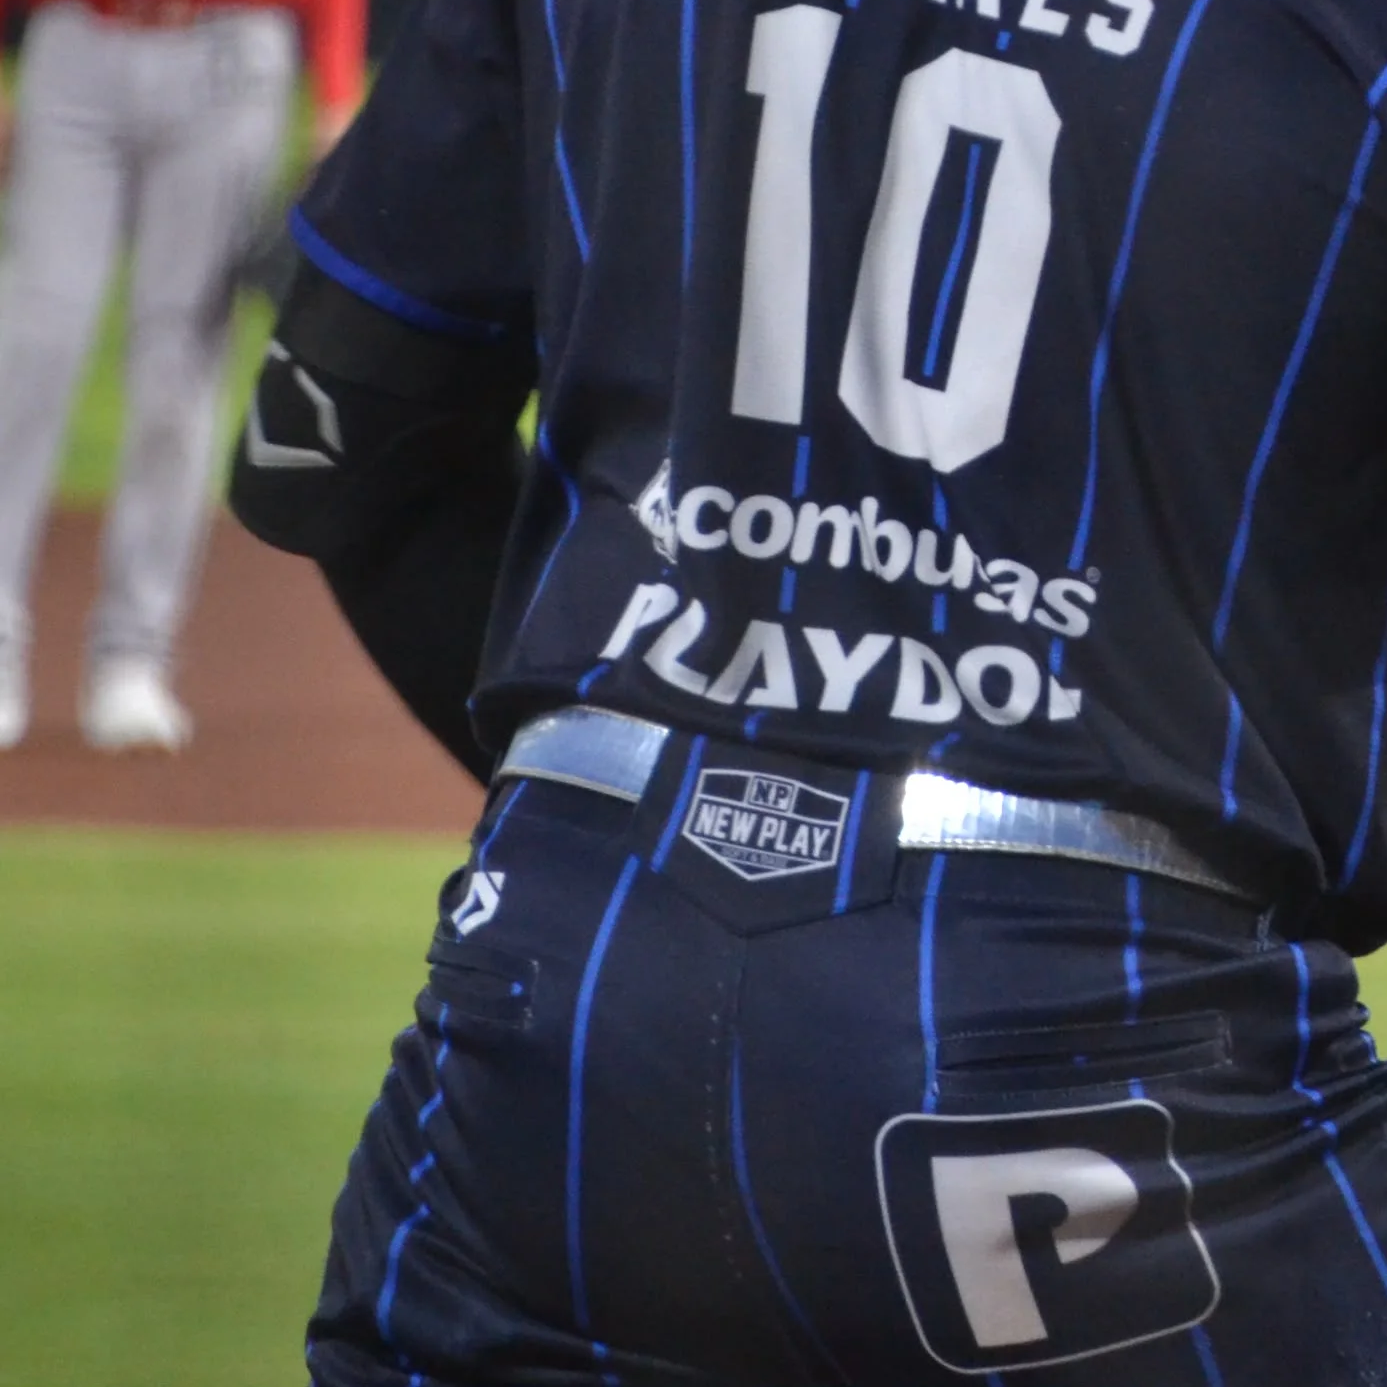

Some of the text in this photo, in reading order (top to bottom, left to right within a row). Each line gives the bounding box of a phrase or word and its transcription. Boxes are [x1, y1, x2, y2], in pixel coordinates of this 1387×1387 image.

[730, 4, 1062, 475] 10
[676, 483, 1098, 638] combuas
[695, 804, 757, 844] NEW
[757, 816, 832, 859] PLAY
[930, 1147, 1138, 1348] P
